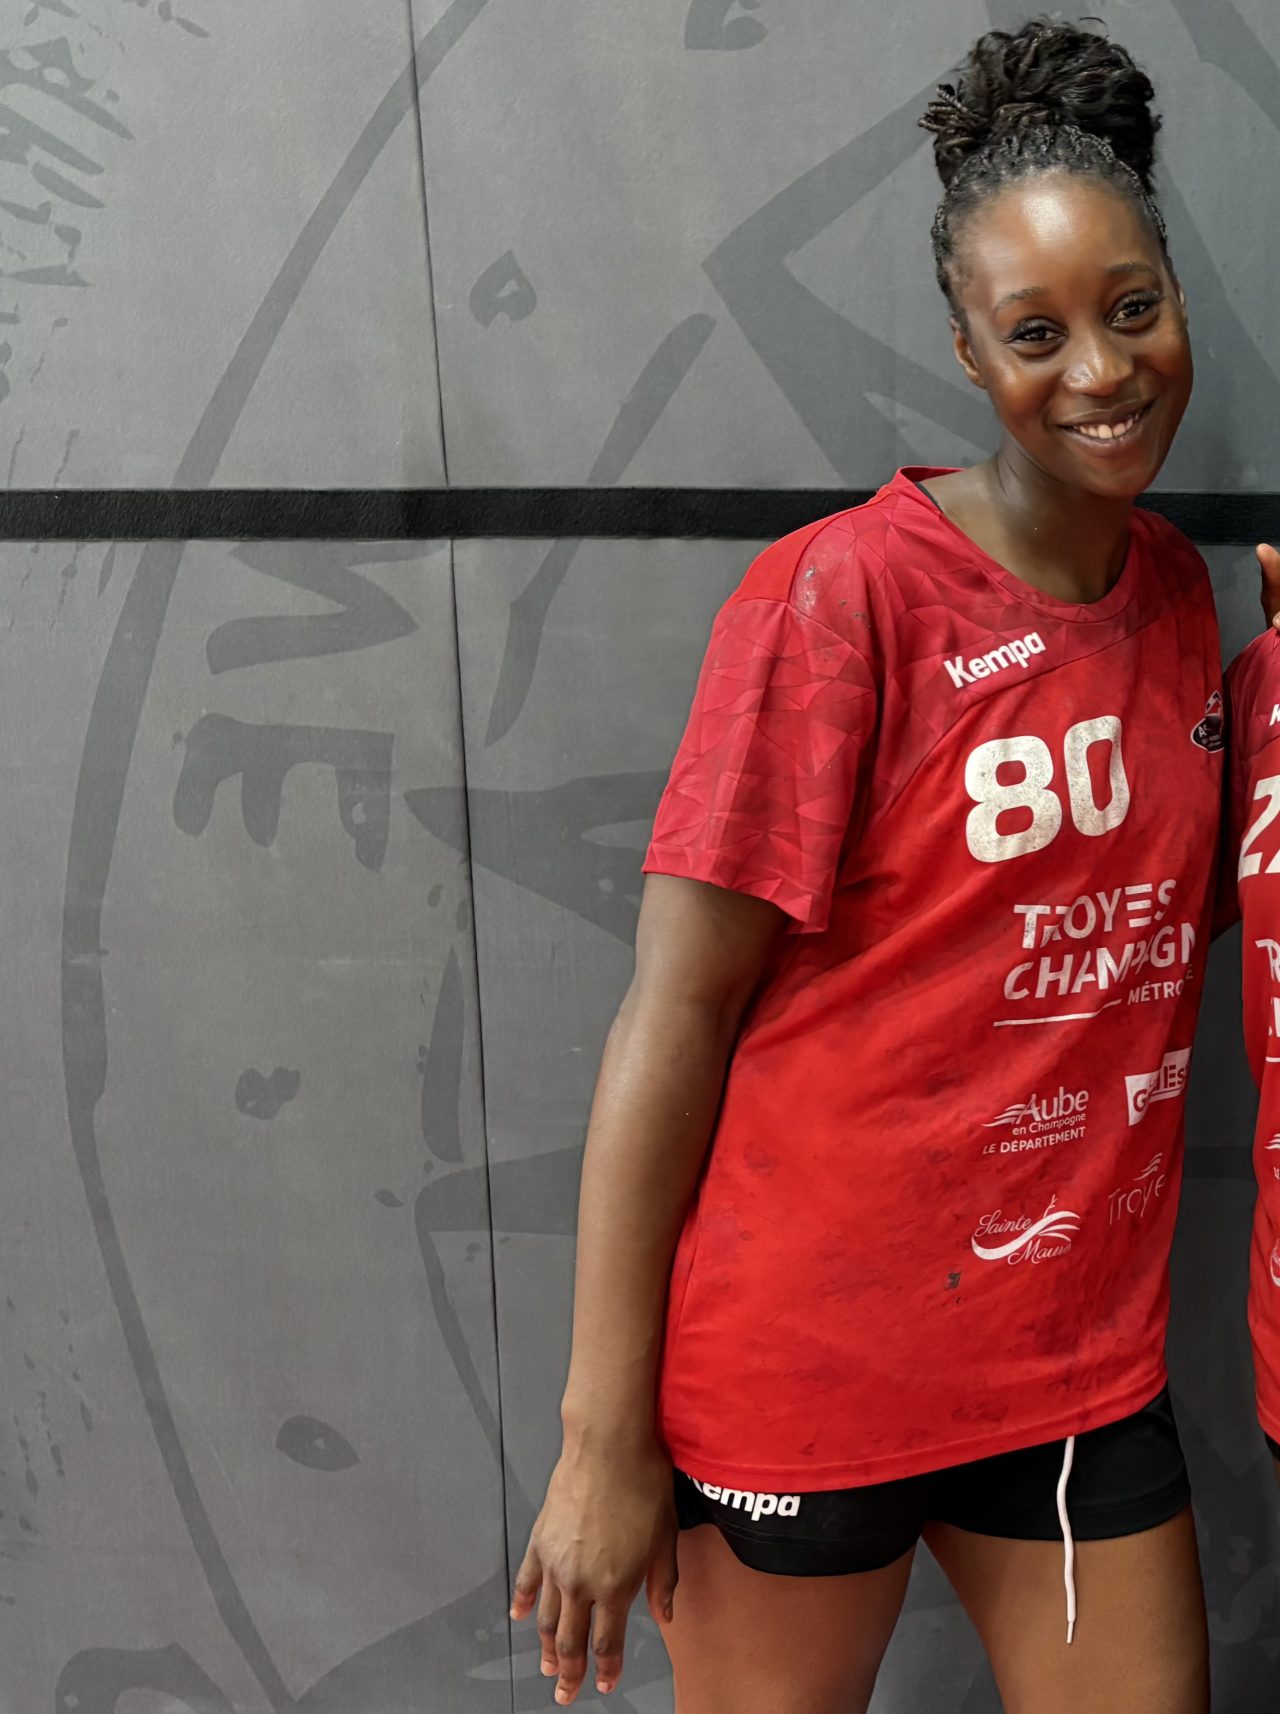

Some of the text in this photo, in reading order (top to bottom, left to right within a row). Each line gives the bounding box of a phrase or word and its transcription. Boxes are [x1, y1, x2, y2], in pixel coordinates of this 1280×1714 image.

[943, 632, 1046, 688] Kempa
[965, 715, 1130, 863] 80
[1004, 922, 1196, 1000] CHAMPAGN
[1128, 979, 1185, 1005] MÉTRO
[1012, 1113, 1086, 1136] en Champagne
[1014, 1086, 1089, 1125] Aube
[982, 1143, 997, 1155] LE
[1108, 1174, 1166, 1226] Troye
[975, 1209, 1033, 1237] Sainte
